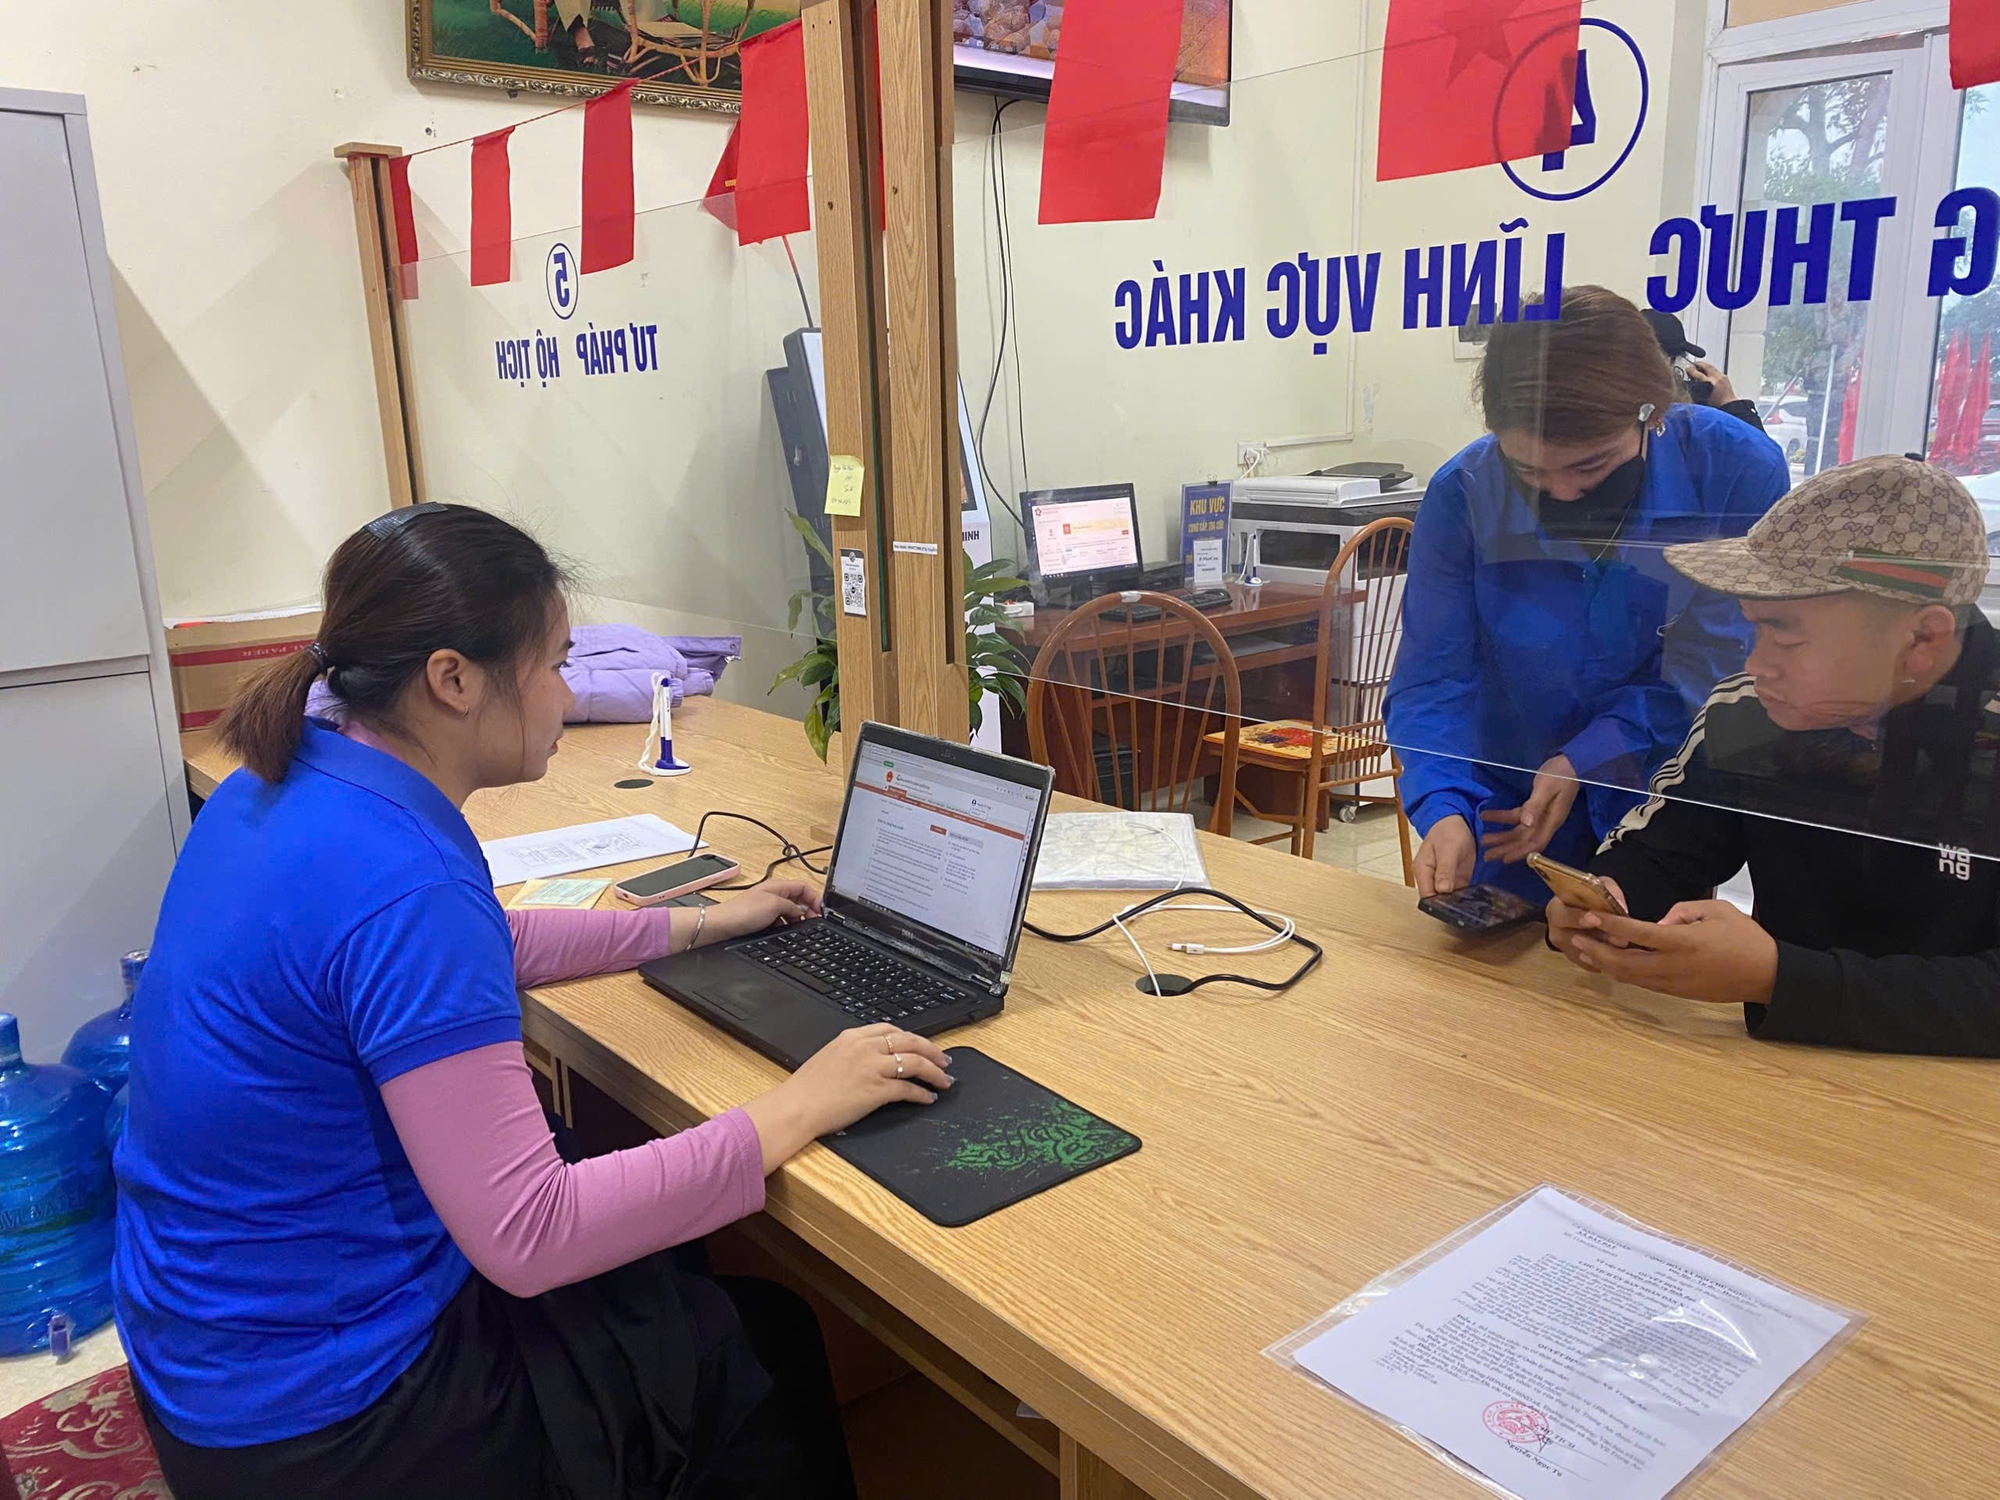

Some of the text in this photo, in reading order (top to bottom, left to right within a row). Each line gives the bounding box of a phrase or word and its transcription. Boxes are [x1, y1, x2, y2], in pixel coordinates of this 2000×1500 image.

[1190, 496, 1226, 517] KHU VỰC
[1506, 1438, 1562, 1478] Nguyễn Ngọc Tú
